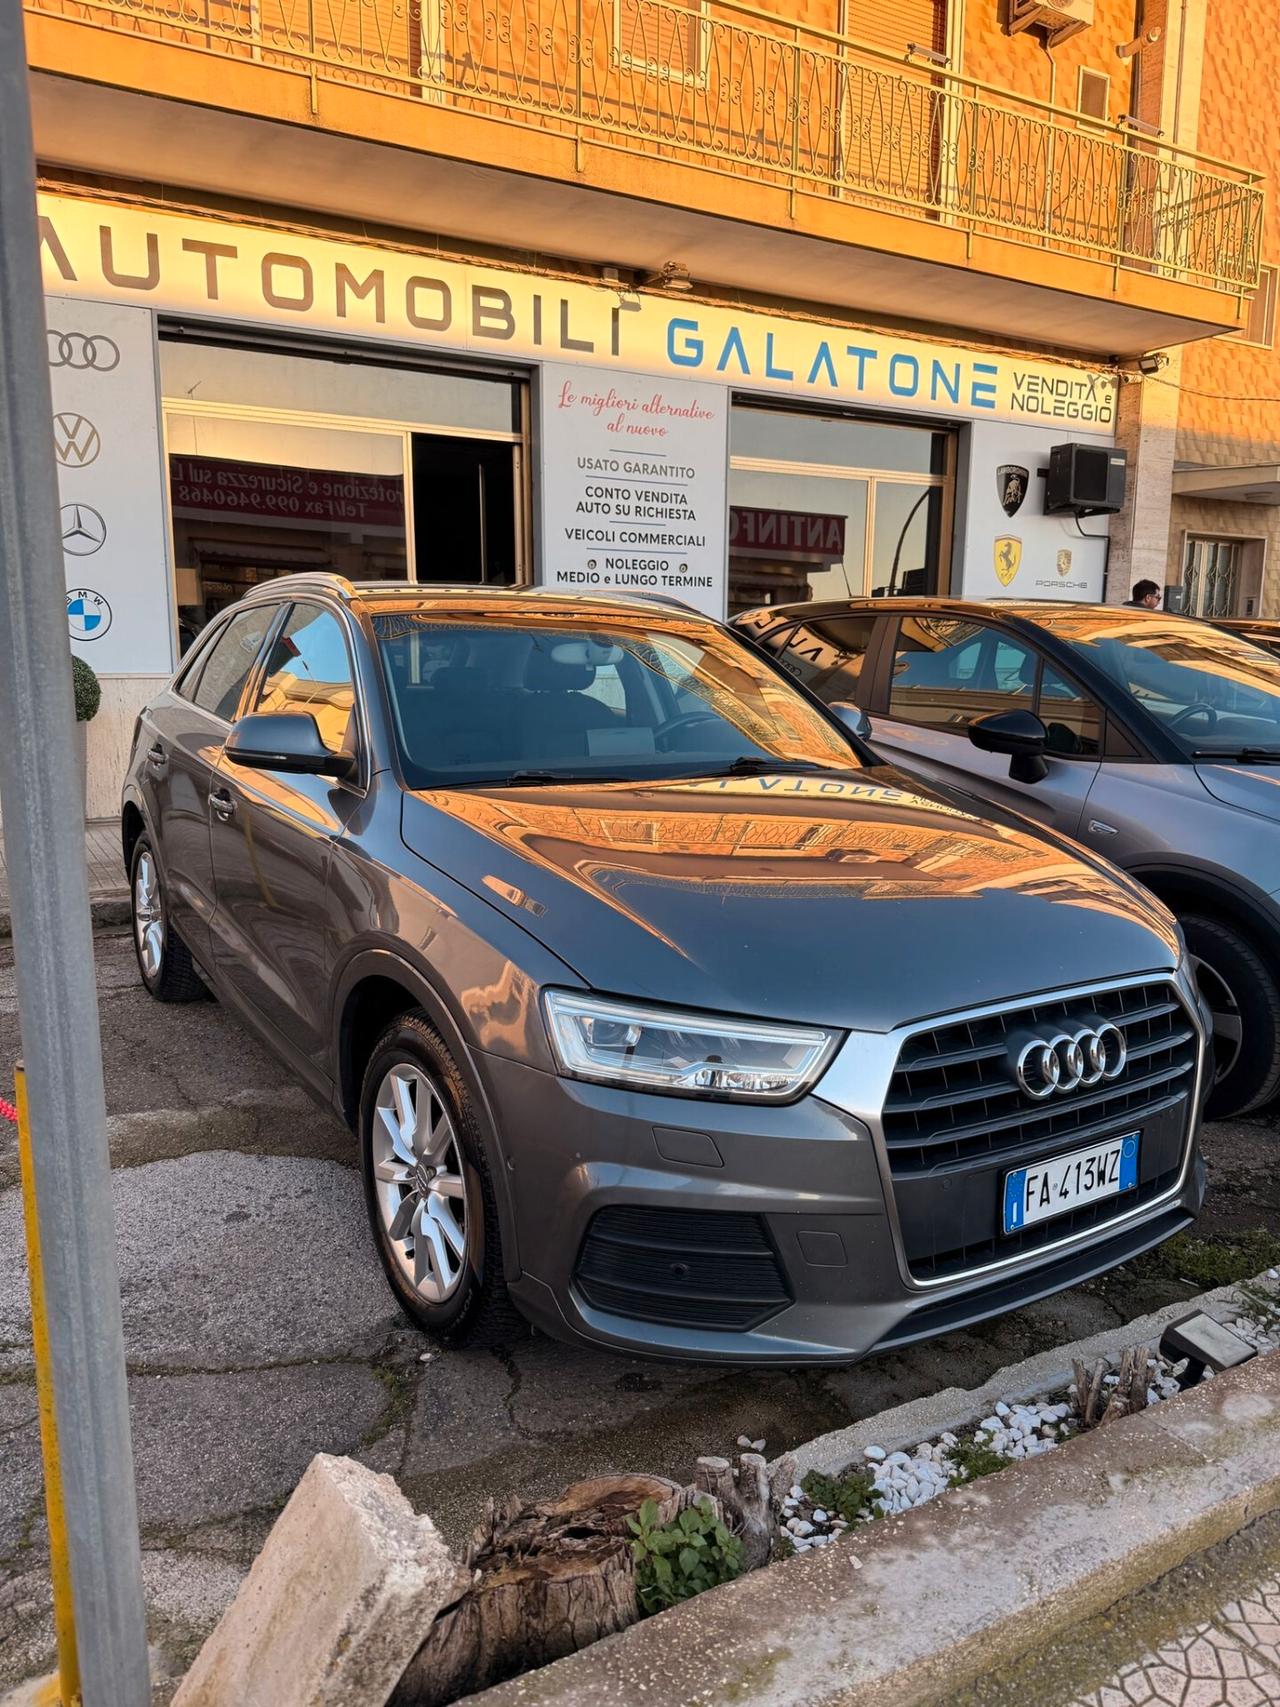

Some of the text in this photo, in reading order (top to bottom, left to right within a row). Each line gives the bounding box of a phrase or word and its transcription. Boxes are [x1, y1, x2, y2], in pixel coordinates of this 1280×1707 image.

[37, 215, 998, 409] AUTOMOBILI GALATONE
[1013, 371, 1113, 404] VENDITA e
[558, 380, 715, 420] Le migliori alternative
[1010, 392, 1112, 423] NOLEGGIO
[607, 412, 669, 437] al nuovo
[577, 456, 696, 479] USATO GARANTITO
[585, 485, 688, 505] CONTO VENDITA
[576, 501, 697, 521] AUTO SU RICHIESTA
[565, 527, 706, 547] VEICOLI COMMERCIALI
[605, 557, 670, 571] NOLEGGIO
[556, 571, 713, 587] MEDIO e LUNGO TERMINE
[1035, 580, 1087, 589] PORSCHE
